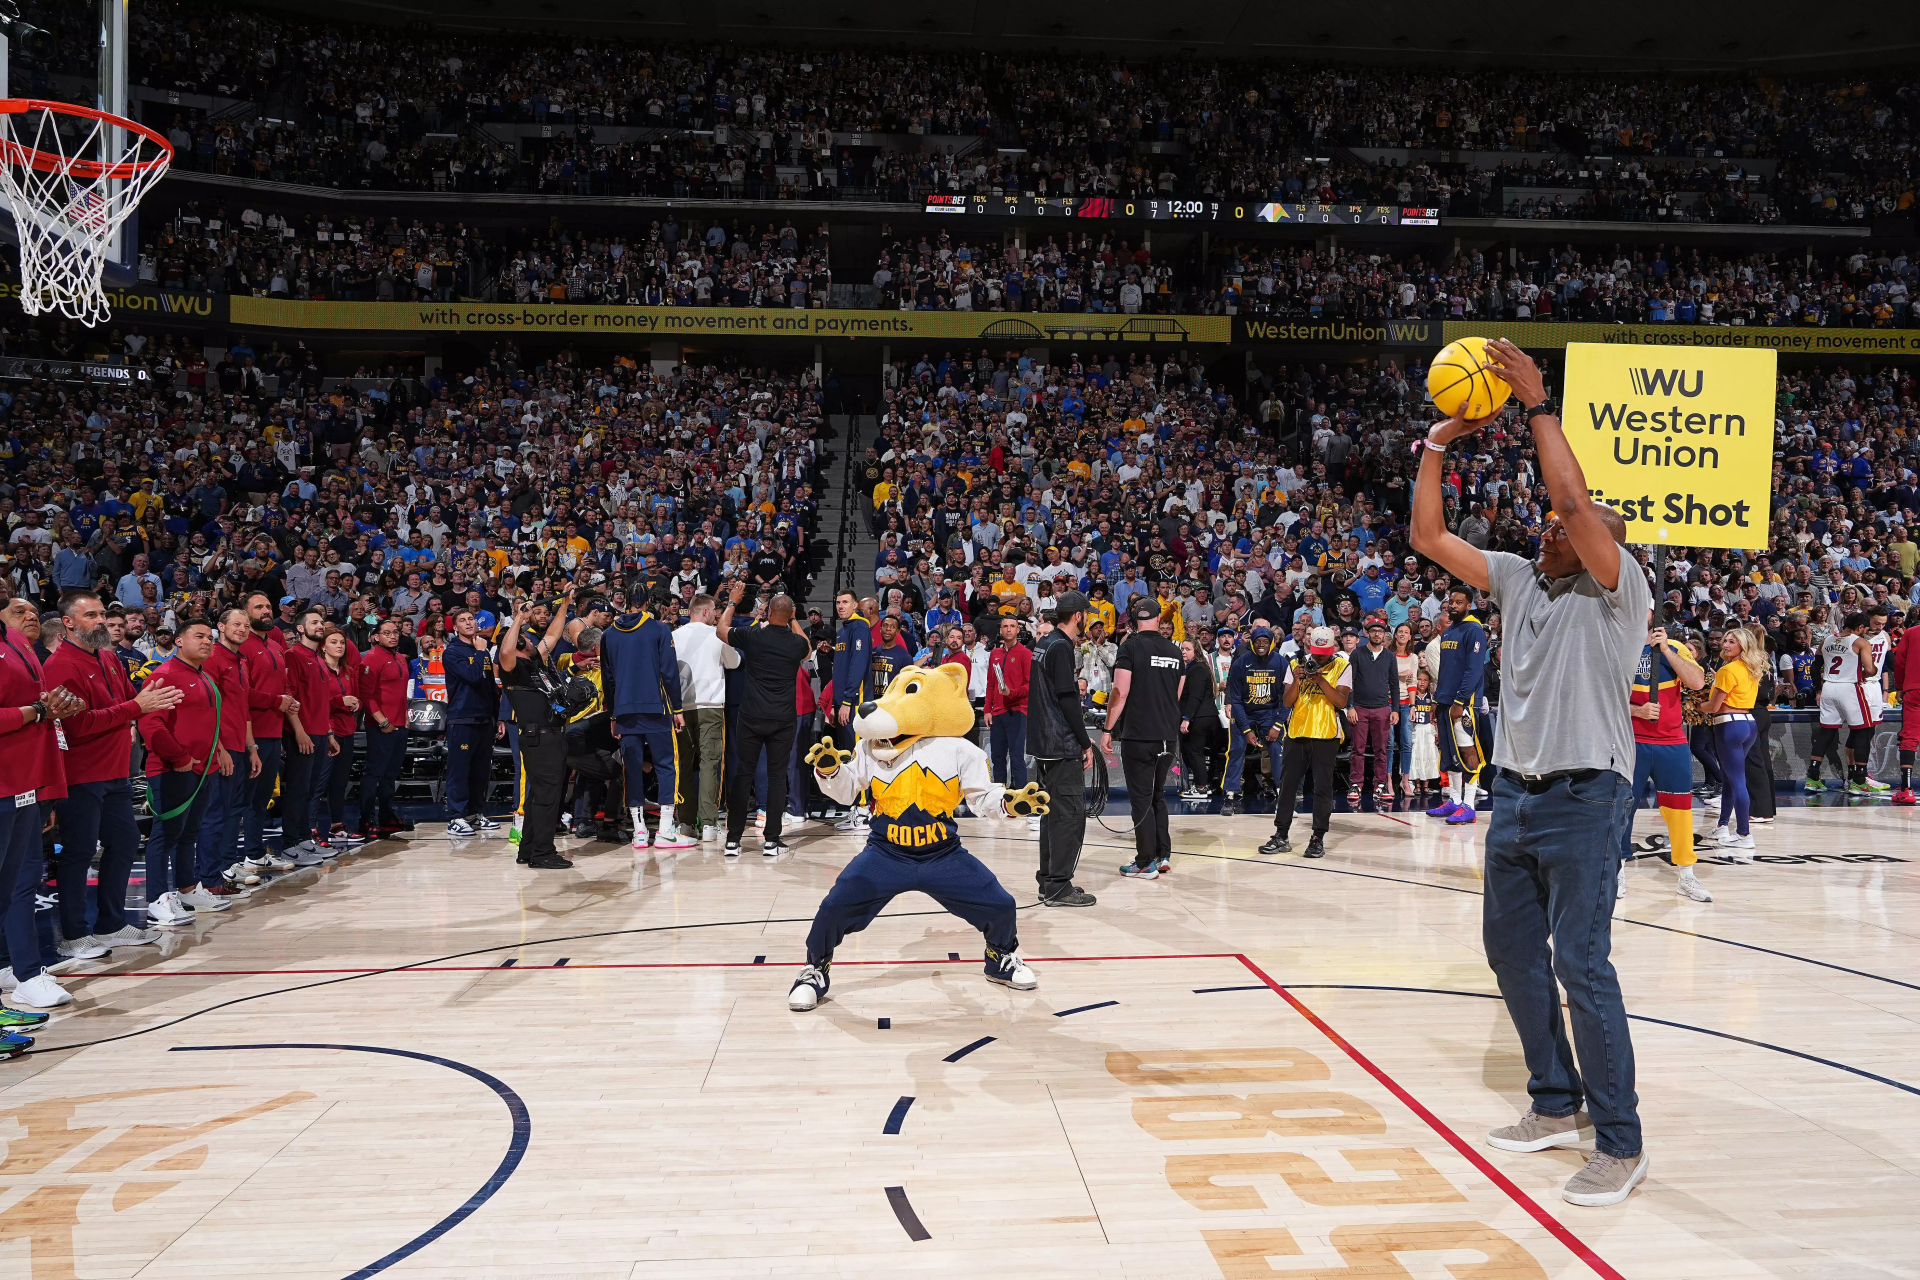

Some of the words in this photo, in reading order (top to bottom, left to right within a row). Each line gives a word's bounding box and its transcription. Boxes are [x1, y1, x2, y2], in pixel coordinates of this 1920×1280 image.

[928, 195, 966, 205] POINTSBET
[977, 205, 984, 213] 0
[1009, 206, 1015, 214] 0
[1038, 207, 1044, 215] 0
[1065, 207, 1072, 216] 0
[1125, 204, 1134, 215] 0
[1167, 201, 1203, 214] 12:00
[1235, 207, 1243, 218] 0
[1402, 207, 1439, 217] POINTSBET
[1212, 212, 1217, 220] 7
[1298, 213, 1303, 222] 0
[1323, 214, 1328, 222] 0
[1354, 215, 1360, 223] 0
[1381, 215, 1387, 224] 0
[167, 294, 212, 316] WU
[419, 308, 460, 325] with
[466, 309, 588, 326] cross-border
[594, 313, 660, 331] money
[664, 314, 767, 329] movement
[772, 314, 809, 330] and
[815, 315, 914, 334] payments.
[1395, 324, 1429, 341] WU
[1602, 329, 1638, 344] with
[1643, 330, 1750, 347] cross-border
[1754, 332, 1811, 350] money
[1816, 334, 1905, 349] movement
[1640, 368, 1704, 397] WU
[1588, 402, 1746, 436] Western
[1613, 435, 1719, 469] Union
[1587, 489, 1655, 522] rst
[1662, 492, 1750, 527] Shot
[1825, 644, 1849, 654] VINCENT
[1150, 655, 1180, 670] ESPN
[1829, 656, 1843, 674] 2
[1246, 676, 1276, 684] NUGGETS
[1256, 683, 1270, 697] NBA
[887, 821, 948, 847] ROCKY
